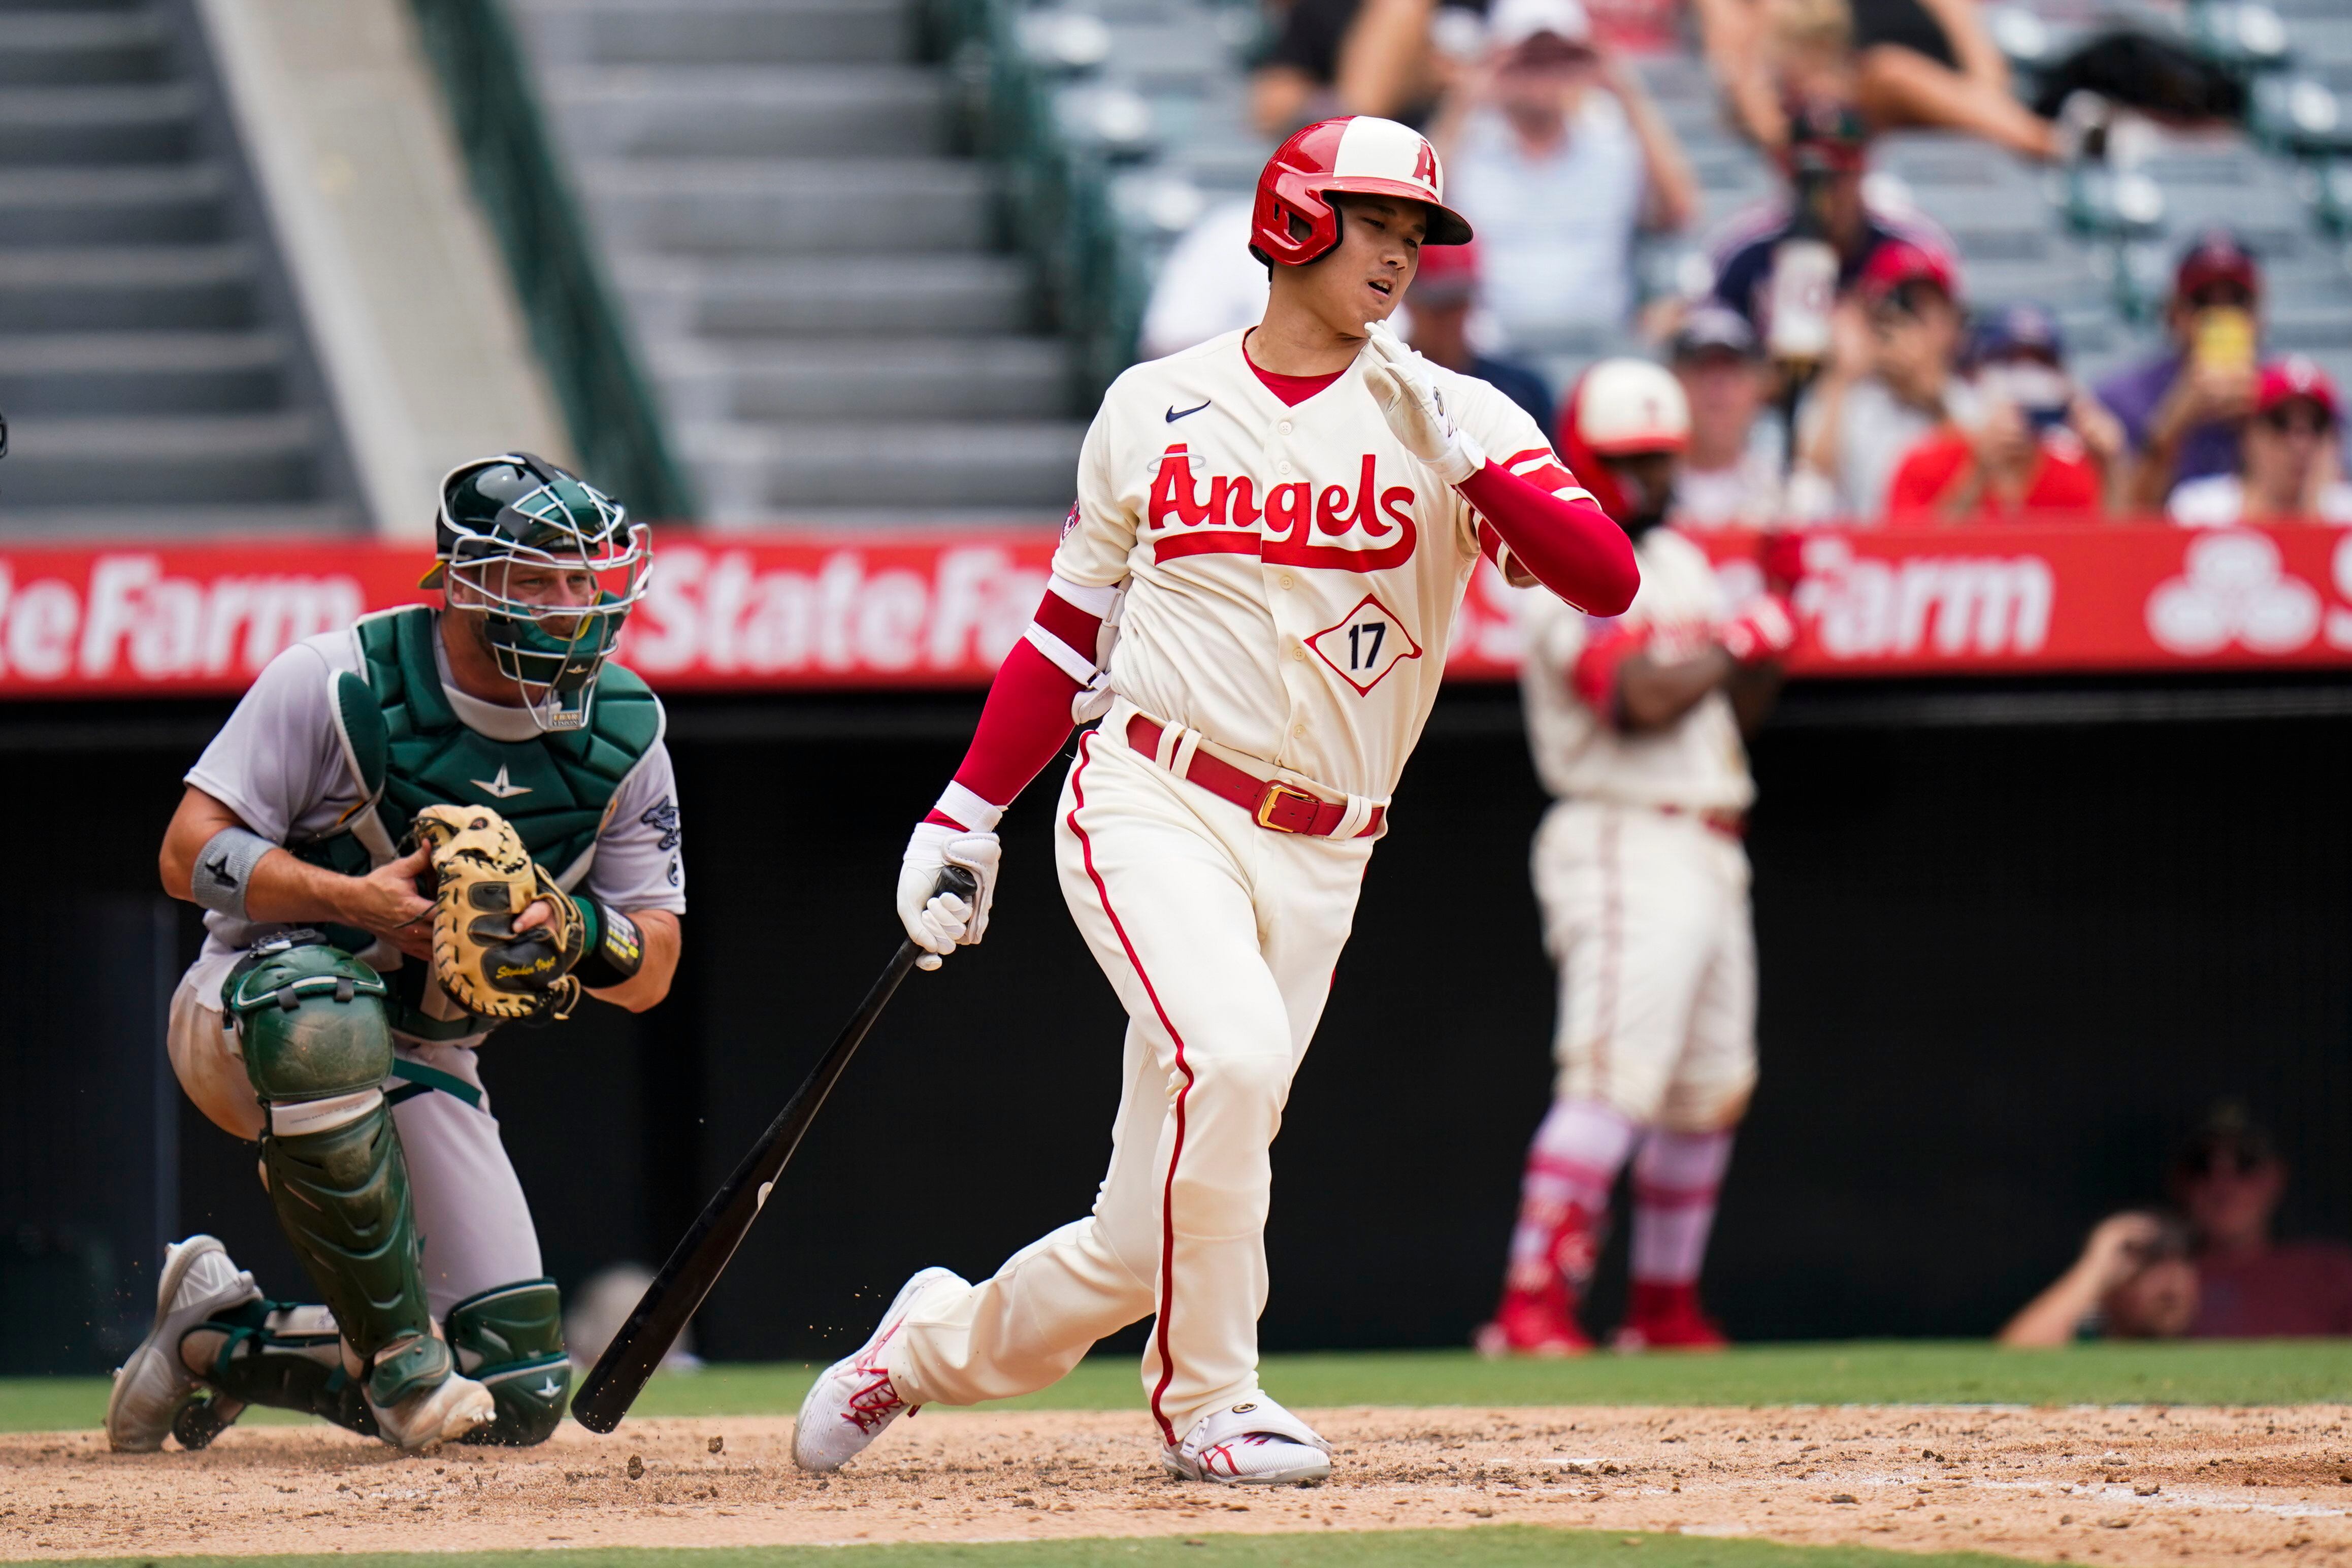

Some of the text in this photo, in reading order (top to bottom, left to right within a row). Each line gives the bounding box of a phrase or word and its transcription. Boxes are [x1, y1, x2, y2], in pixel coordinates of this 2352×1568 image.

[1412, 138, 1438, 190] A
[1148, 443, 1418, 573] Angels
[1349, 622, 1386, 669] 17
